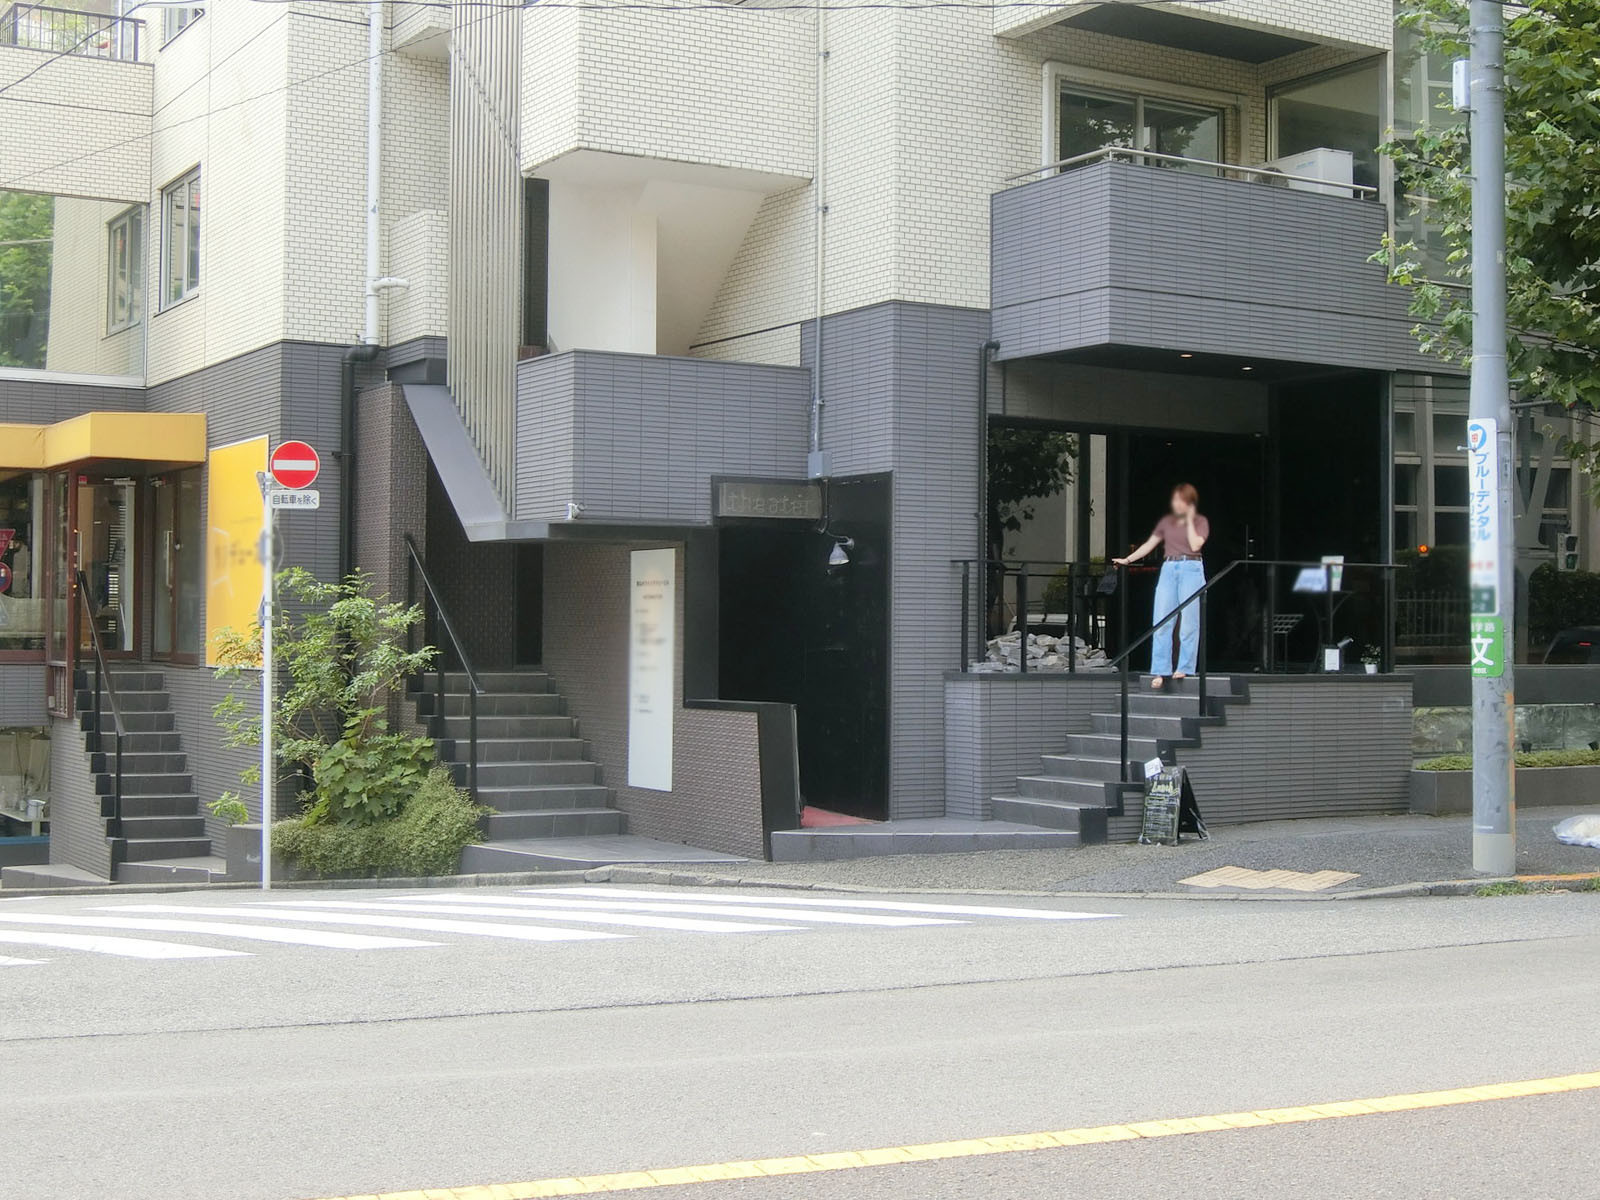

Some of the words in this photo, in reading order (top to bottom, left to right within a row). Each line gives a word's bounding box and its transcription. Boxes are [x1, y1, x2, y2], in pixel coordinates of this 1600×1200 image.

[272, 494, 317, 505] 自転車を除く
[1475, 453, 1491, 541] ブルーデンタル
[1471, 633, 1495, 666] 文
